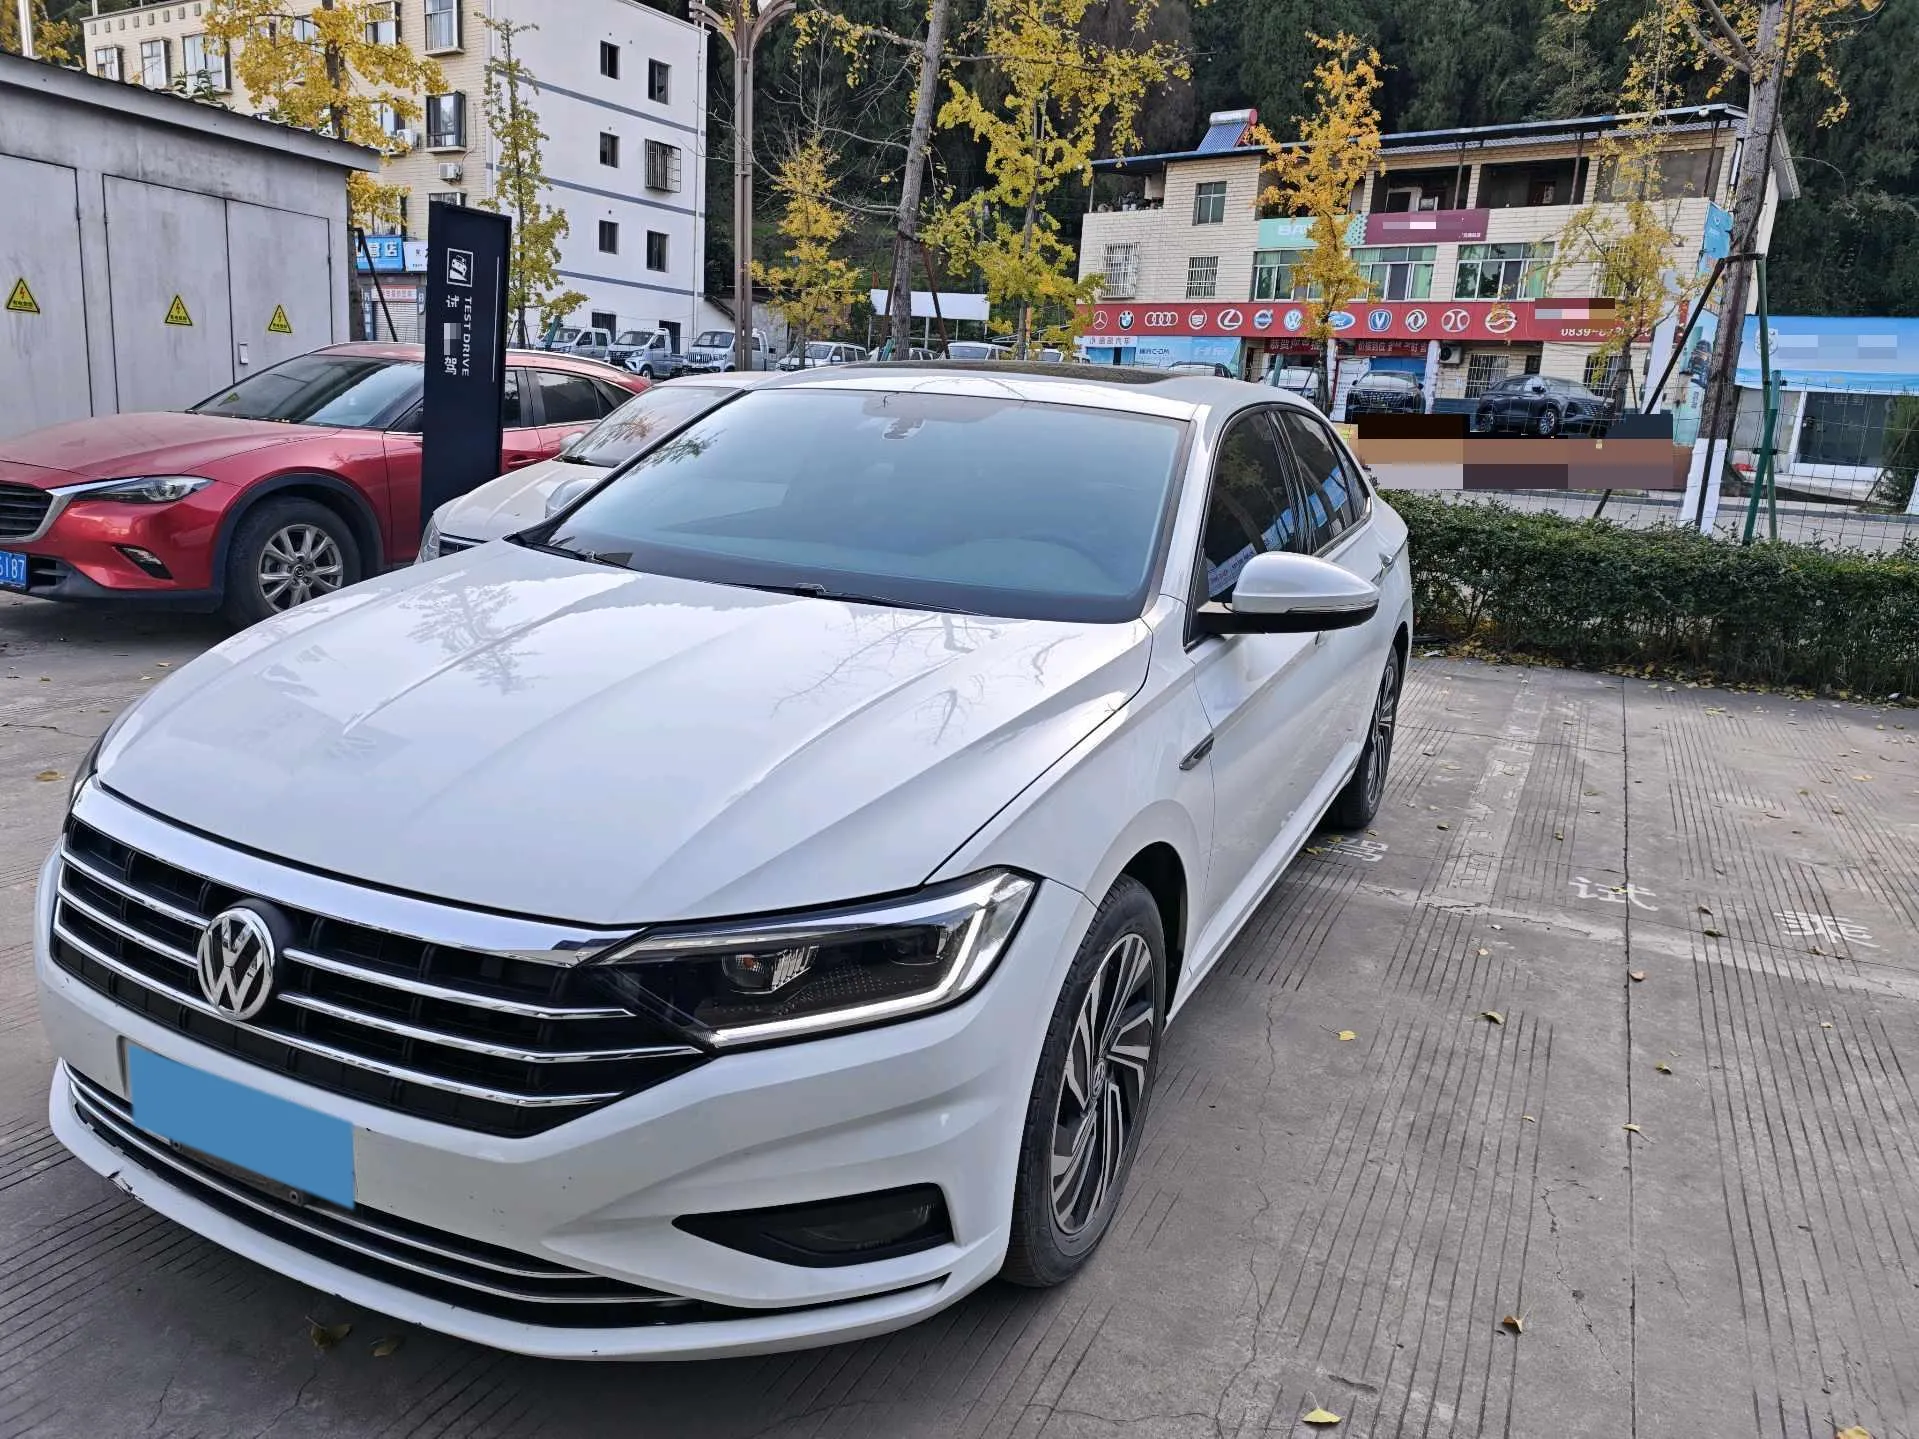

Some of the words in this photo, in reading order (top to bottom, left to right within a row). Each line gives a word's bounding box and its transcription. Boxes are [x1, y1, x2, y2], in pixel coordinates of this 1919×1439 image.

[463, 296, 473, 331] TEST
[462, 333, 471, 377] DRIVE
[1567, 876, 1659, 911] 试
[1773, 910, 1881, 948] 乘
